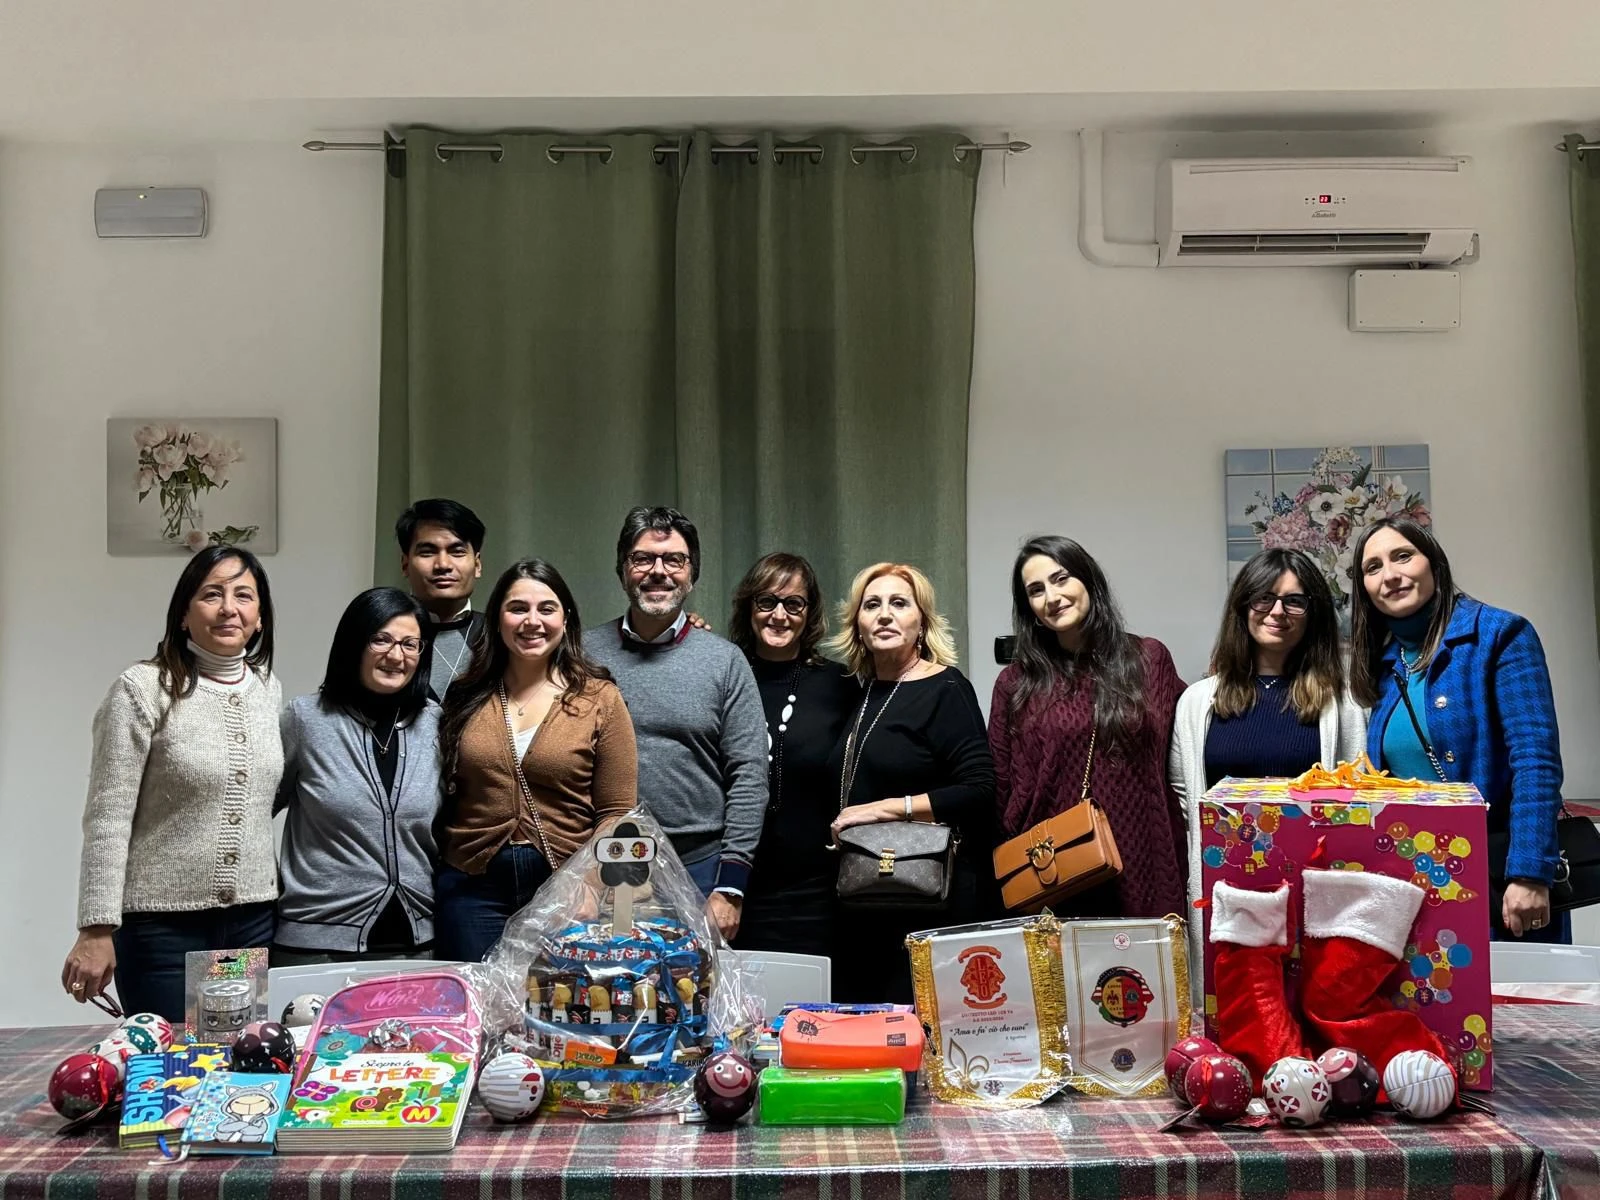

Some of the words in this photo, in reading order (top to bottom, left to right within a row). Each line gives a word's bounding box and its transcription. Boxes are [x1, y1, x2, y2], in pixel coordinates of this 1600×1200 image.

[999, 1023, 1011, 1032] che
[329, 1066, 440, 1084] LETTERE
[123, 1054, 166, 1125] SHOW!
[407, 1107, 431, 1121] M
